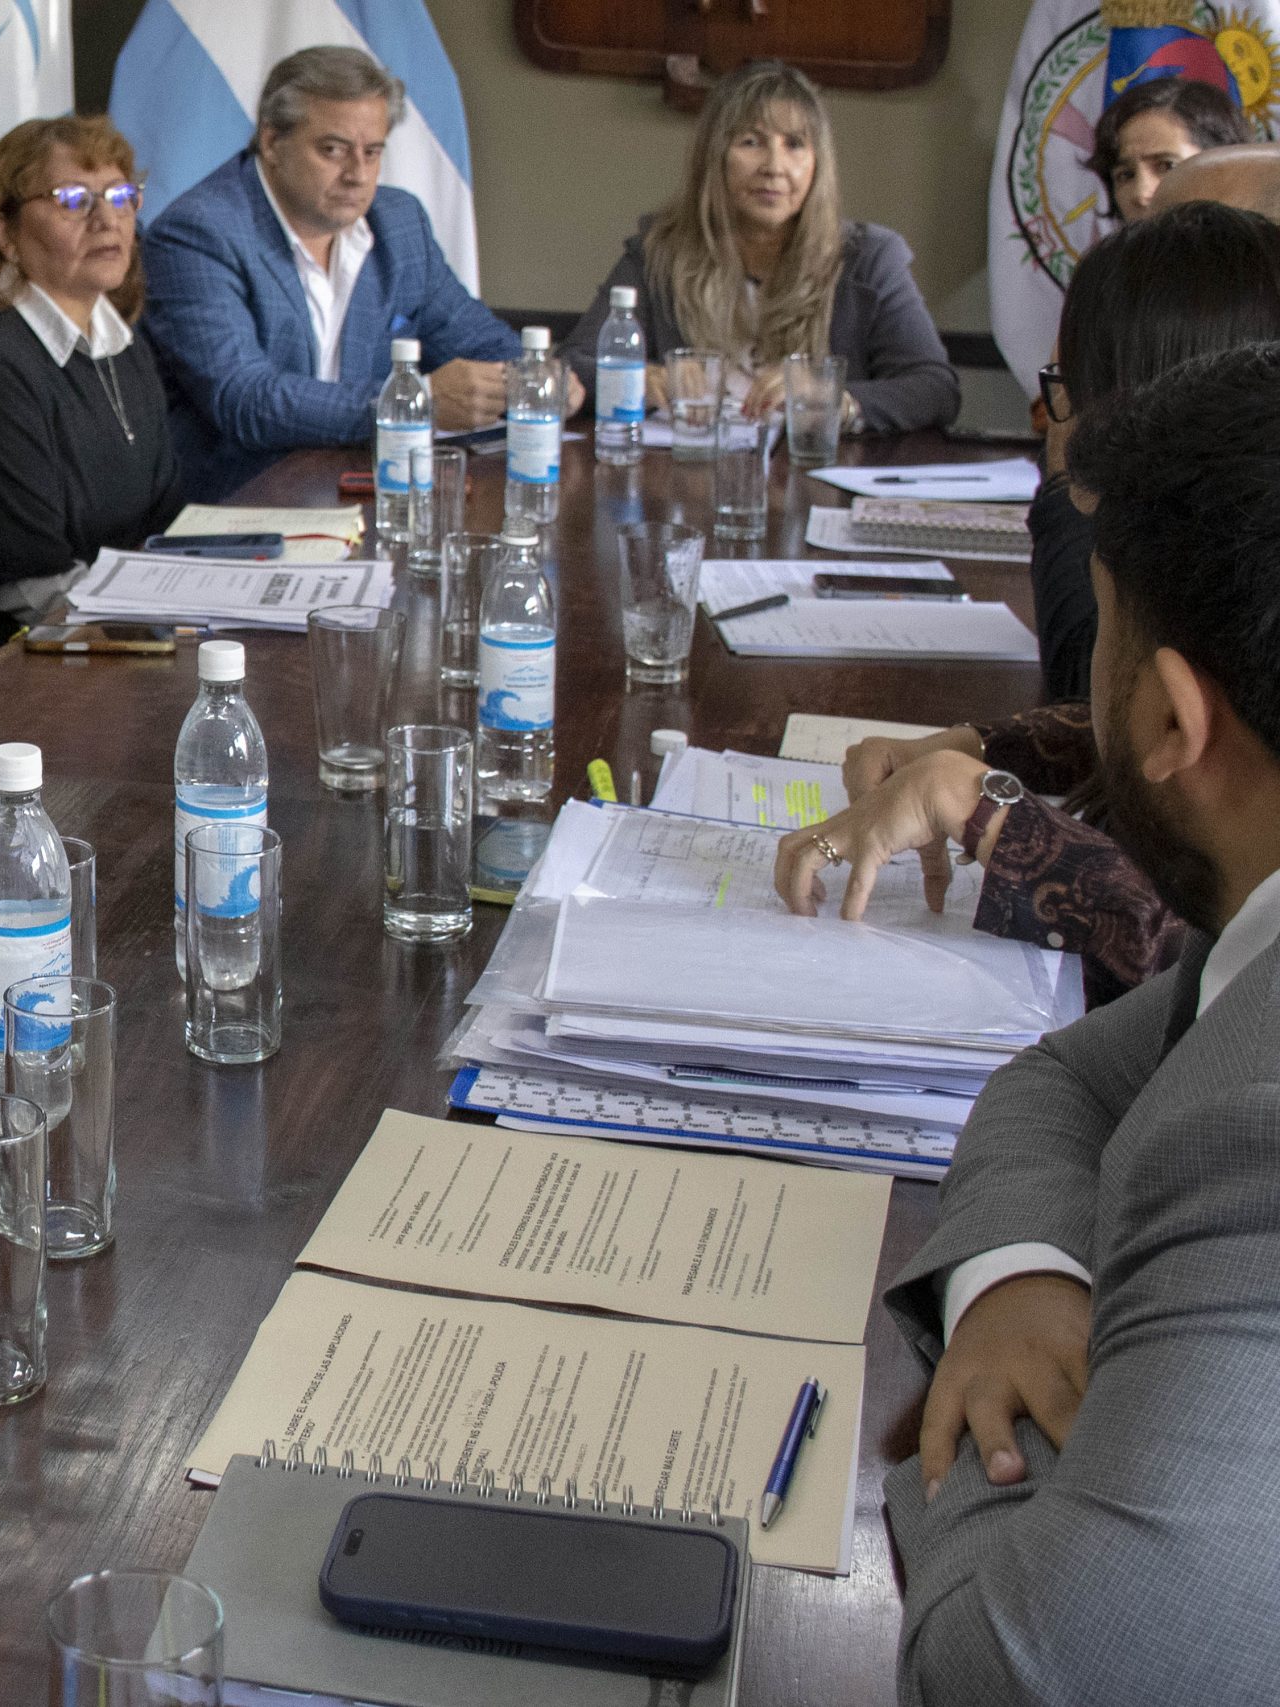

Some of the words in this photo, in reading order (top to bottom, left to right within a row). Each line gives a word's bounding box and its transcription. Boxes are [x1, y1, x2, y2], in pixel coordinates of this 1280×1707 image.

[316, 1358, 331, 1371] LAS
[311, 1371, 325, 1380] DE
[299, 1380, 321, 1404] PORQUE
[295, 1404, 309, 1413] EL
[283, 1413, 304, 1436] SOBRE
[666, 1428, 682, 1454] FUERTE
